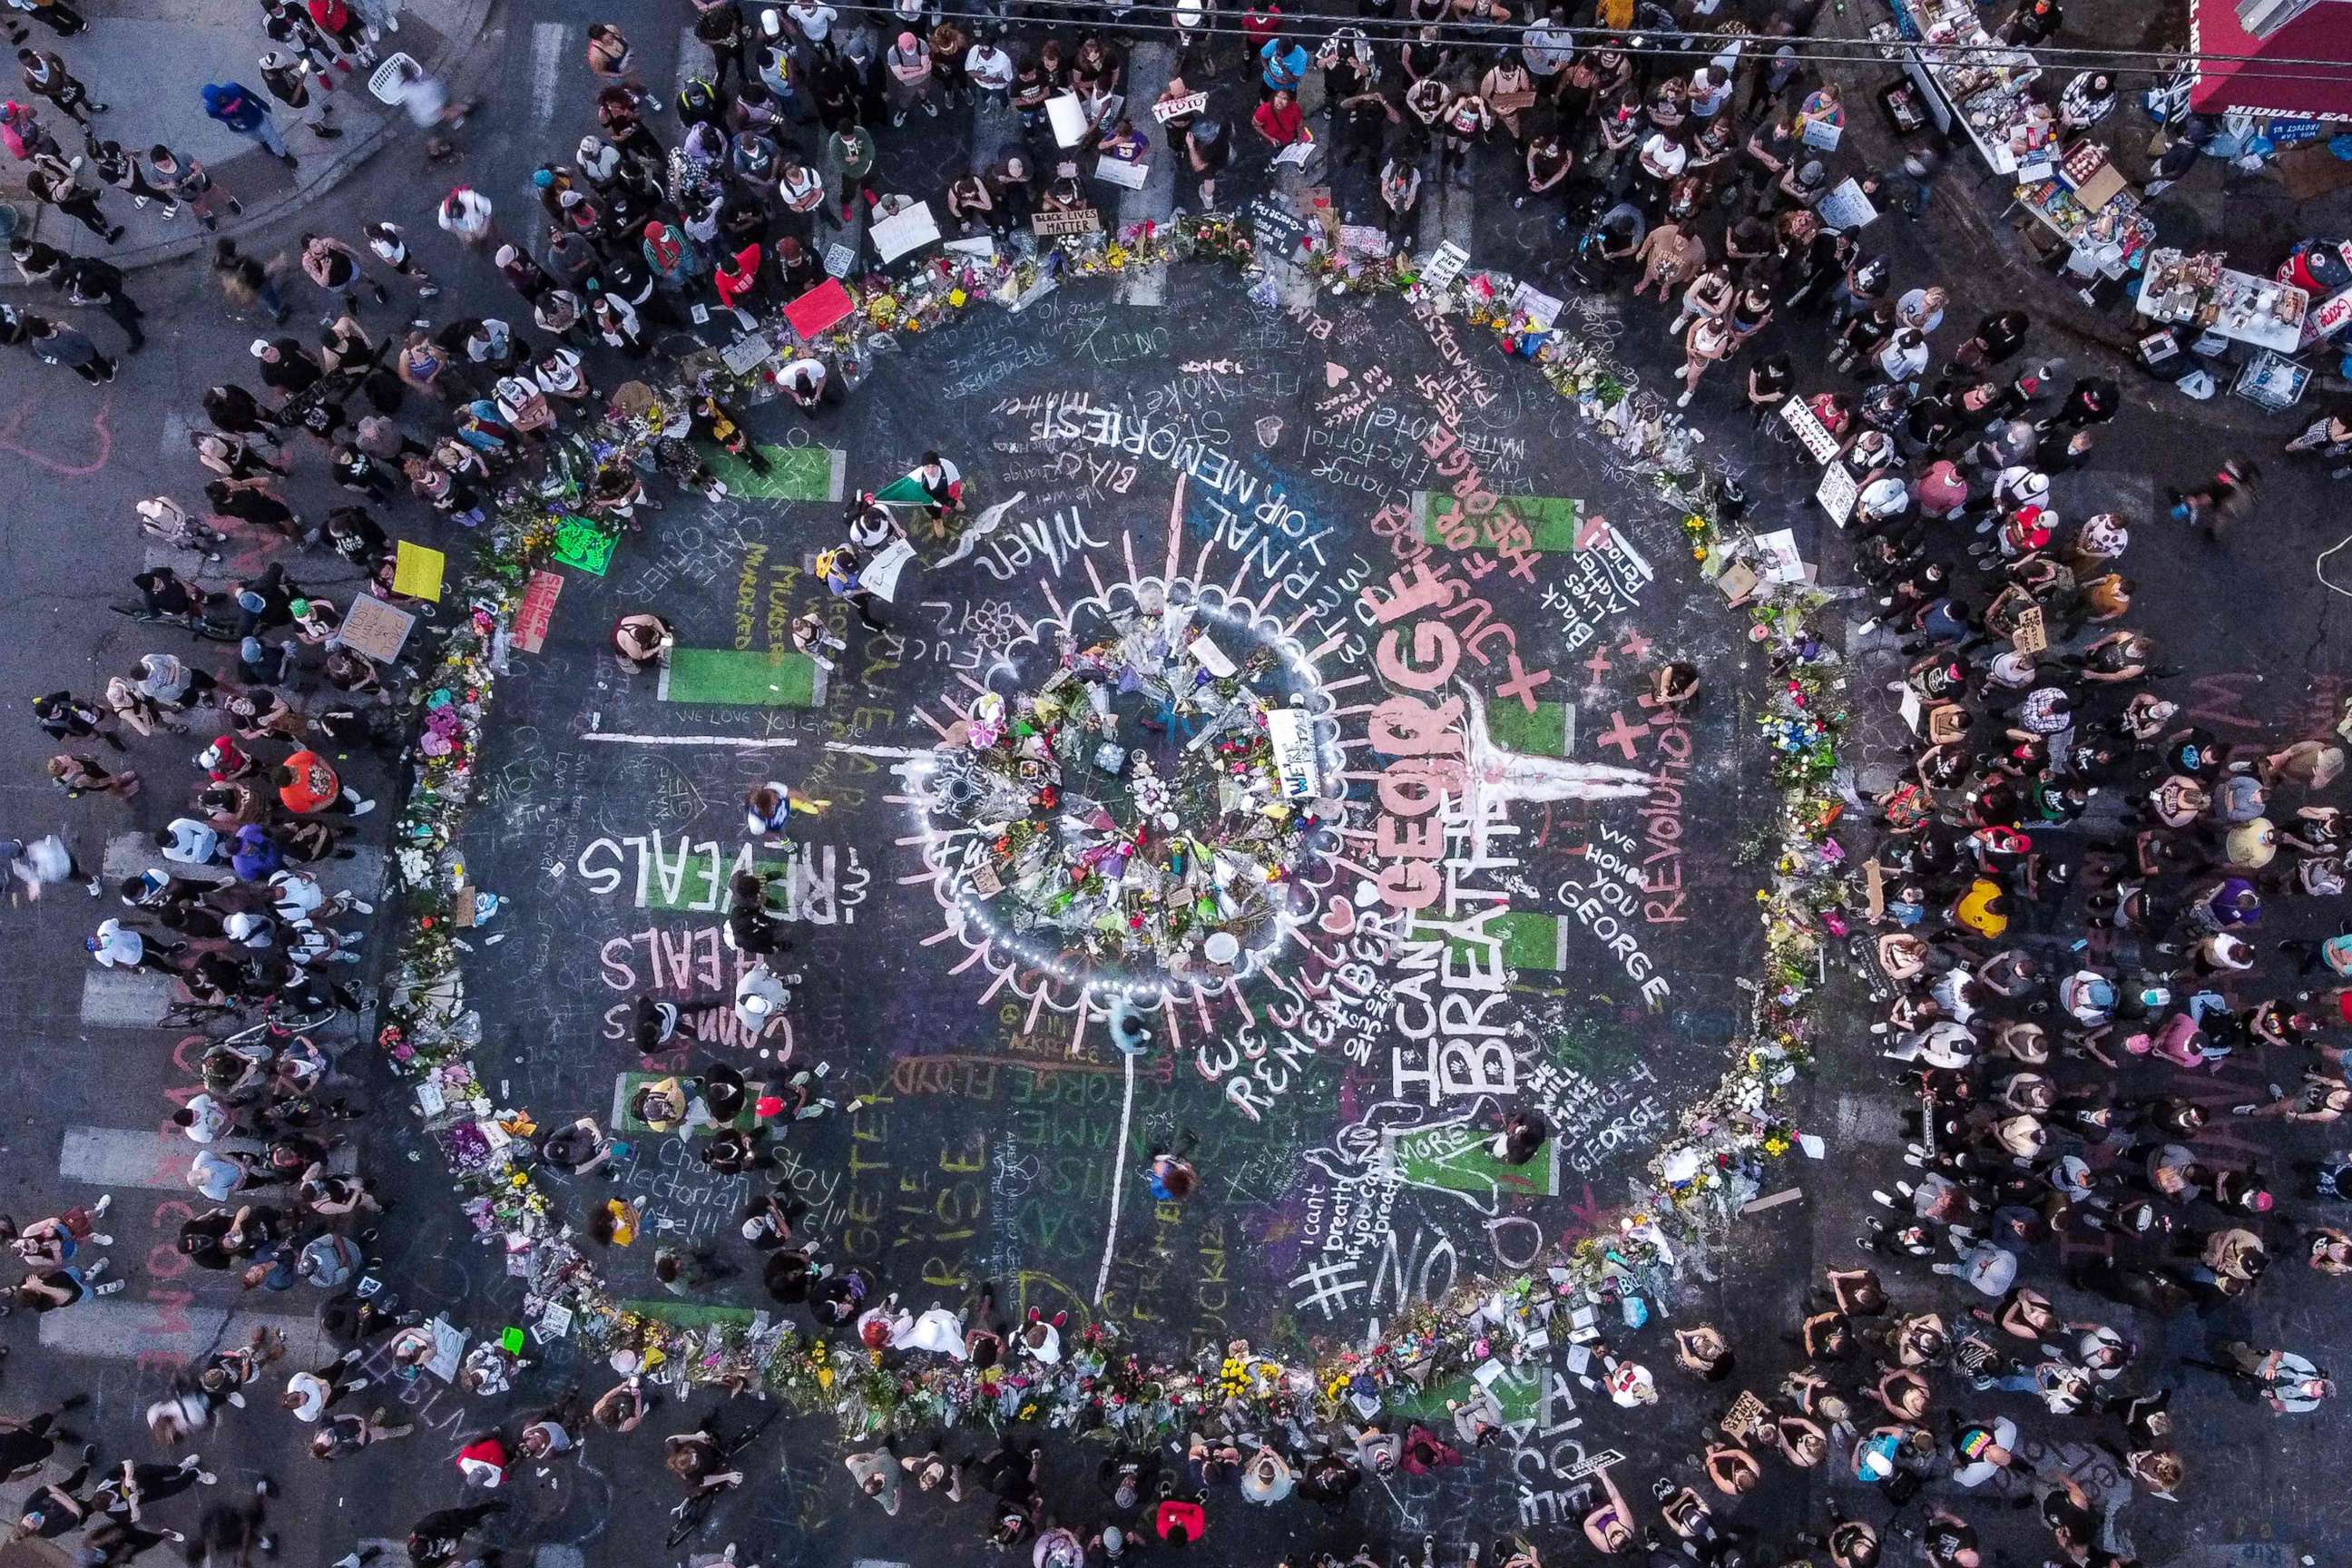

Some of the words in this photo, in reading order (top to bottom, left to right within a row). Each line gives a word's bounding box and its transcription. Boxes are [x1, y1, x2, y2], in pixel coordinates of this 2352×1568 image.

[2190, 18, 2201, 85] MEAT
[2223, 104, 2316, 120] MIDDLE
[2317, 112, 2352, 122] EA
[1035, 212, 1063, 222] BLACK
[1067, 210, 1097, 220] LIVES
[1046, 220, 1090, 233] MATTER
[943, 341, 1056, 400] REMEMBER
[1413, 300, 1497, 408] PARADISE
[1413, 371, 1464, 429] REST
[1794, 397, 1811, 417] NOT
[1809, 418, 1836, 448] TODAY
[1302, 425, 1431, 485] Electorial
[1309, 456, 1411, 515] Change
[683, 516, 765, 587] CARE
[535, 575, 562, 637] SILENCE
[1564, 573, 1607, 625] Lives
[1573, 551, 1627, 614] Matter
[1540, 582, 1596, 652] Black
[709, 710, 750, 725] LOVE
[1360, 559, 1465, 909] GEORGE
[1599, 822, 1638, 855] WE
[1589, 867, 1639, 918] YOU
[1558, 877, 1671, 1014] GEORGE
[1226, 910, 1405, 1122] REMEMBER
[1344, 1036, 1373, 1067] NO
[1392, 1036, 1441, 1107] I
[1527, 1059, 1558, 1093] WE
[1534, 1066, 1580, 1114] WILL
[1549, 1074, 1600, 1131] MAKE
[1002, 1131, 1020, 1179] ALREADY
[1571, 1095, 1670, 1173] GEORGE
[765, 1145, 841, 1207] Stay
[1006, 1187, 1019, 1211] MISS
[1723, 1393, 1749, 1427] NAMES
[1730, 1398, 1756, 1432] THEIR
[1743, 1403, 1761, 1426] SAY
